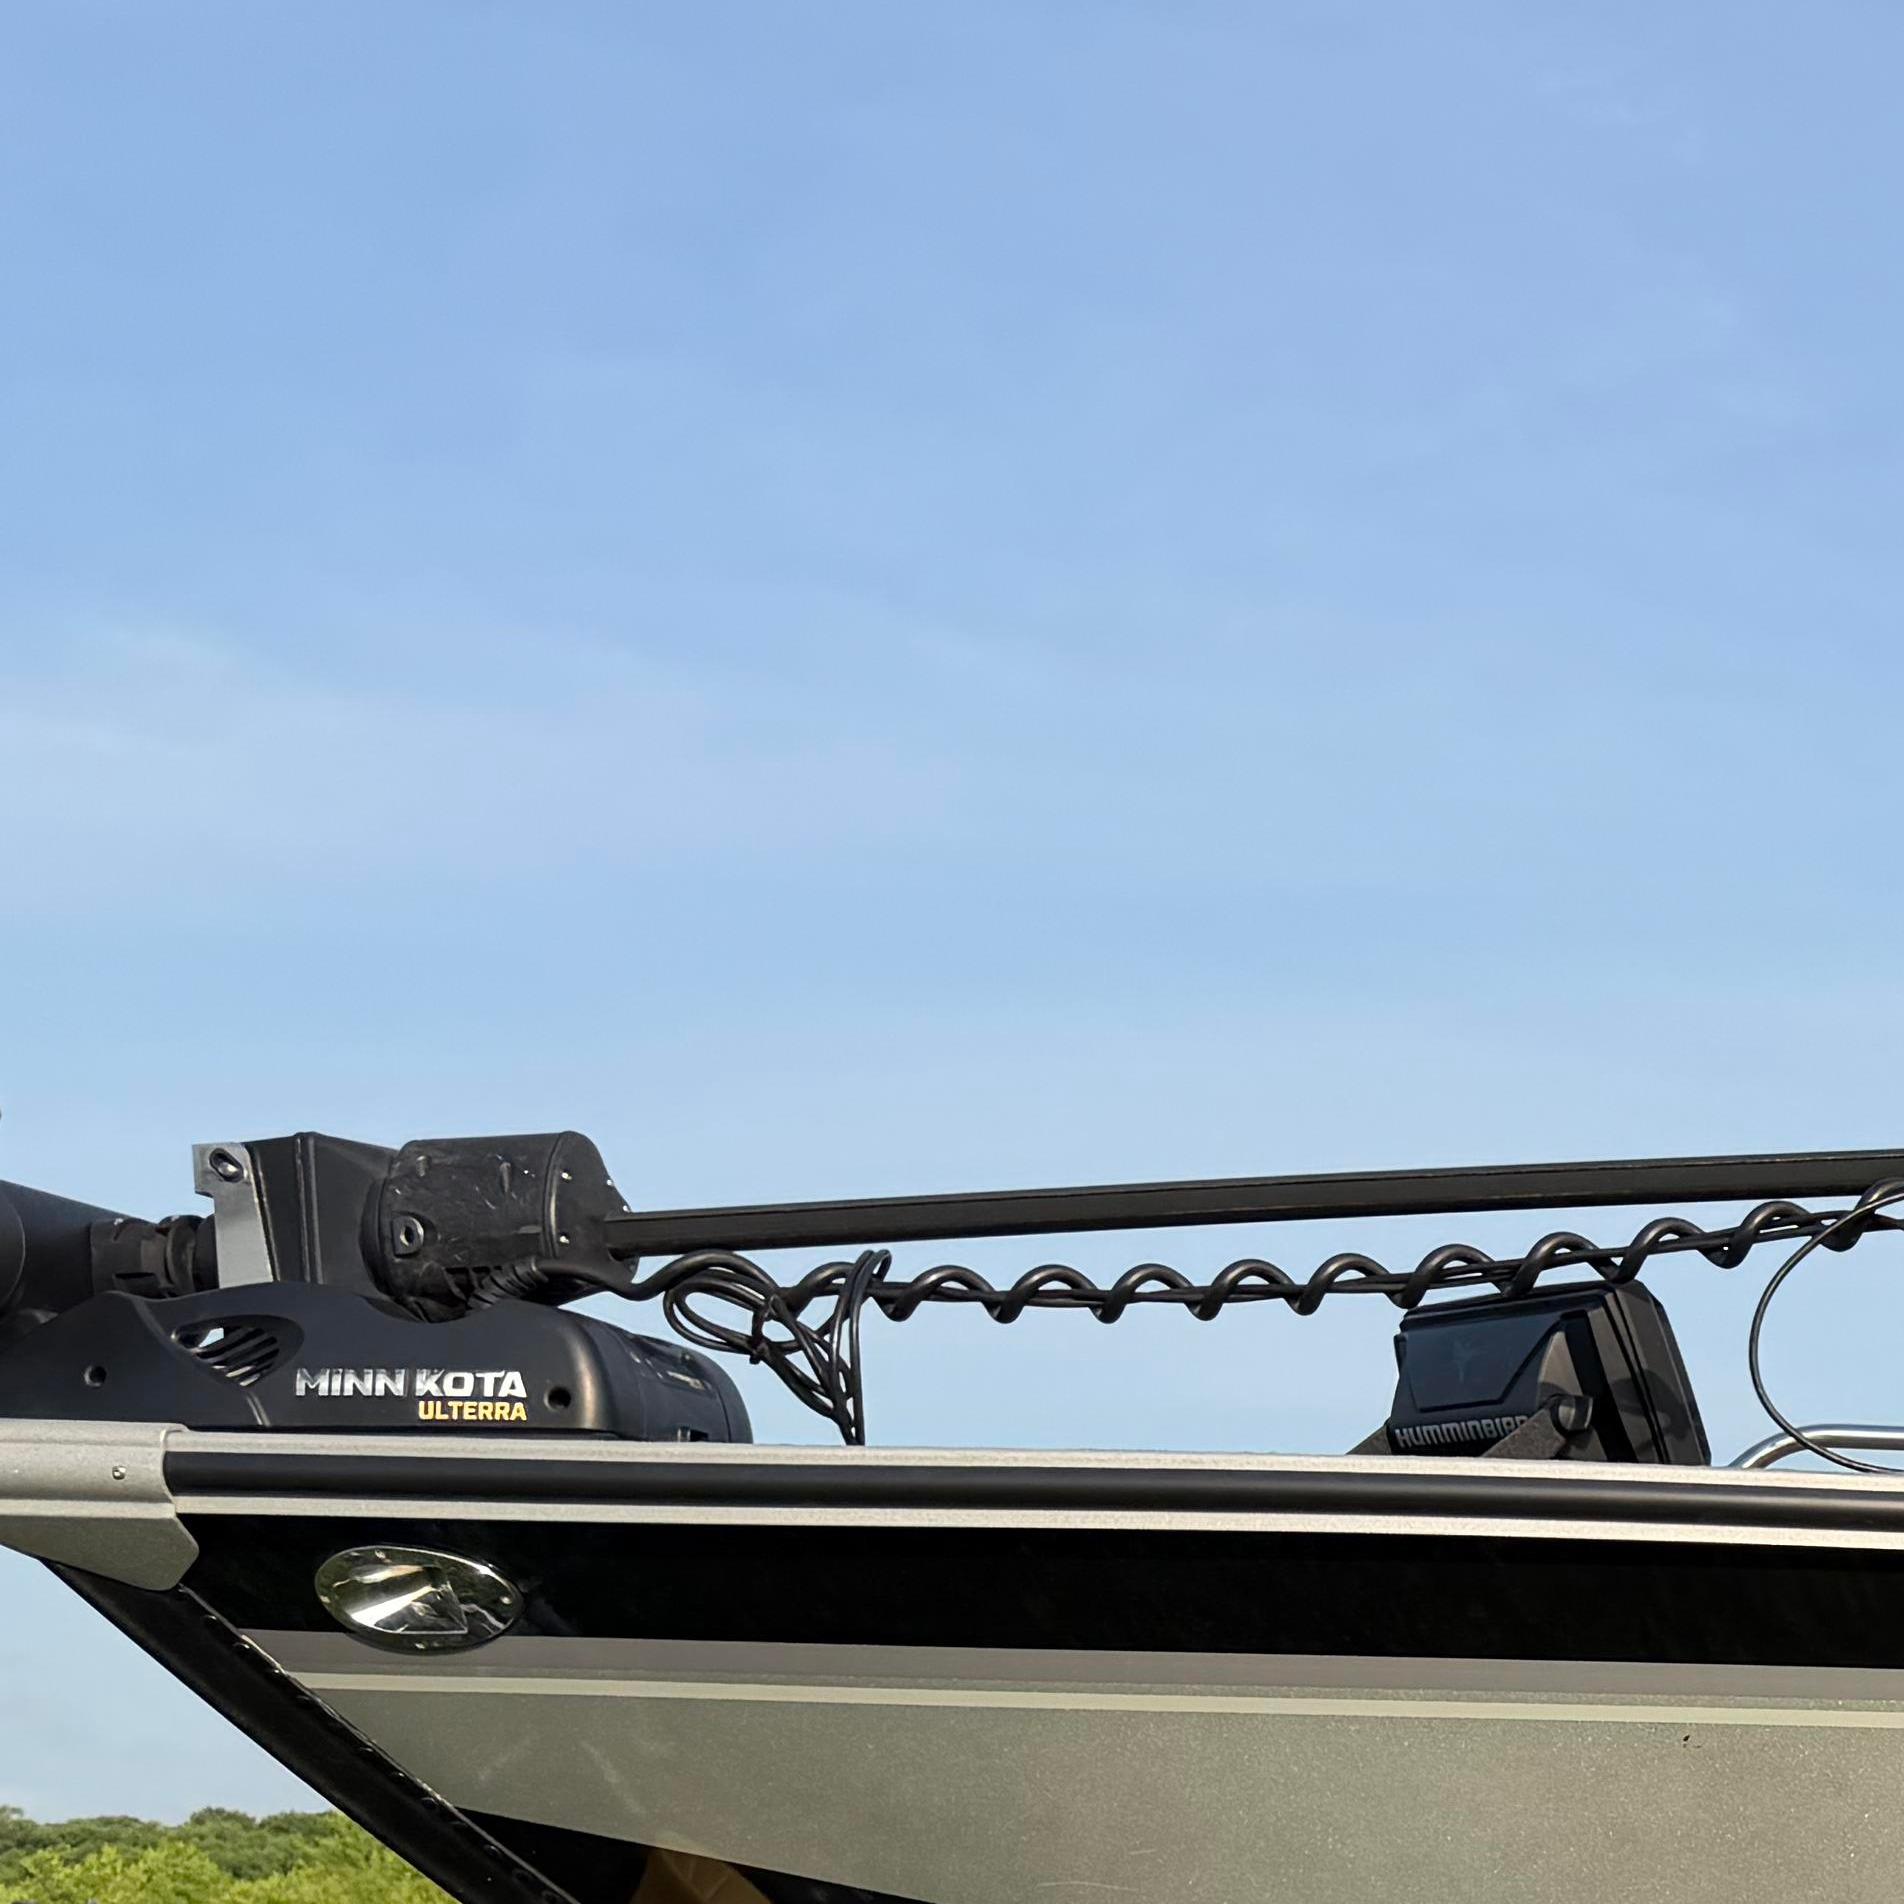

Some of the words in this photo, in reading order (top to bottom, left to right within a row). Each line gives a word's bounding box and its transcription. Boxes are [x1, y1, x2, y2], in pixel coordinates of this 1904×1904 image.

[295, 1368, 405, 1397] MINN
[415, 1368, 527, 1398] KOTA
[418, 1401, 527, 1421] ULTERRA
